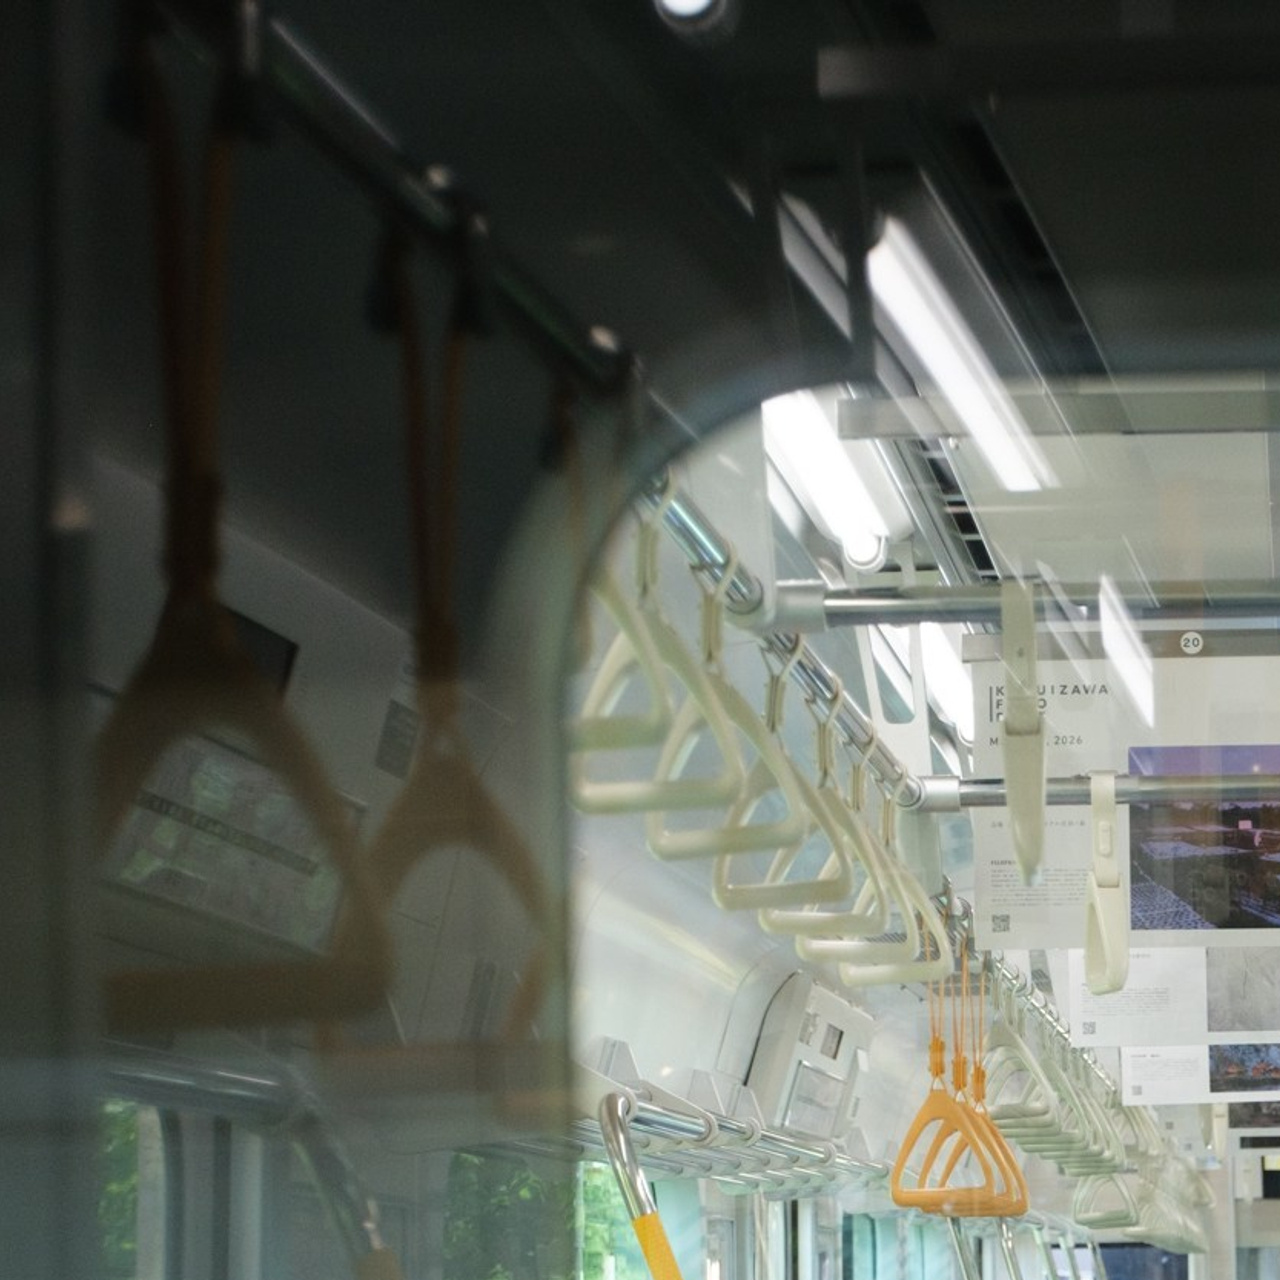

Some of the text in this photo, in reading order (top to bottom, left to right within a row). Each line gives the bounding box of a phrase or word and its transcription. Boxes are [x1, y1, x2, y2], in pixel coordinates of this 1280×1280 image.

[1182, 637, 1200, 648] 20
[996, 685, 1109, 696] KUIZAWA
[1053, 735, 1083, 746] 2026
